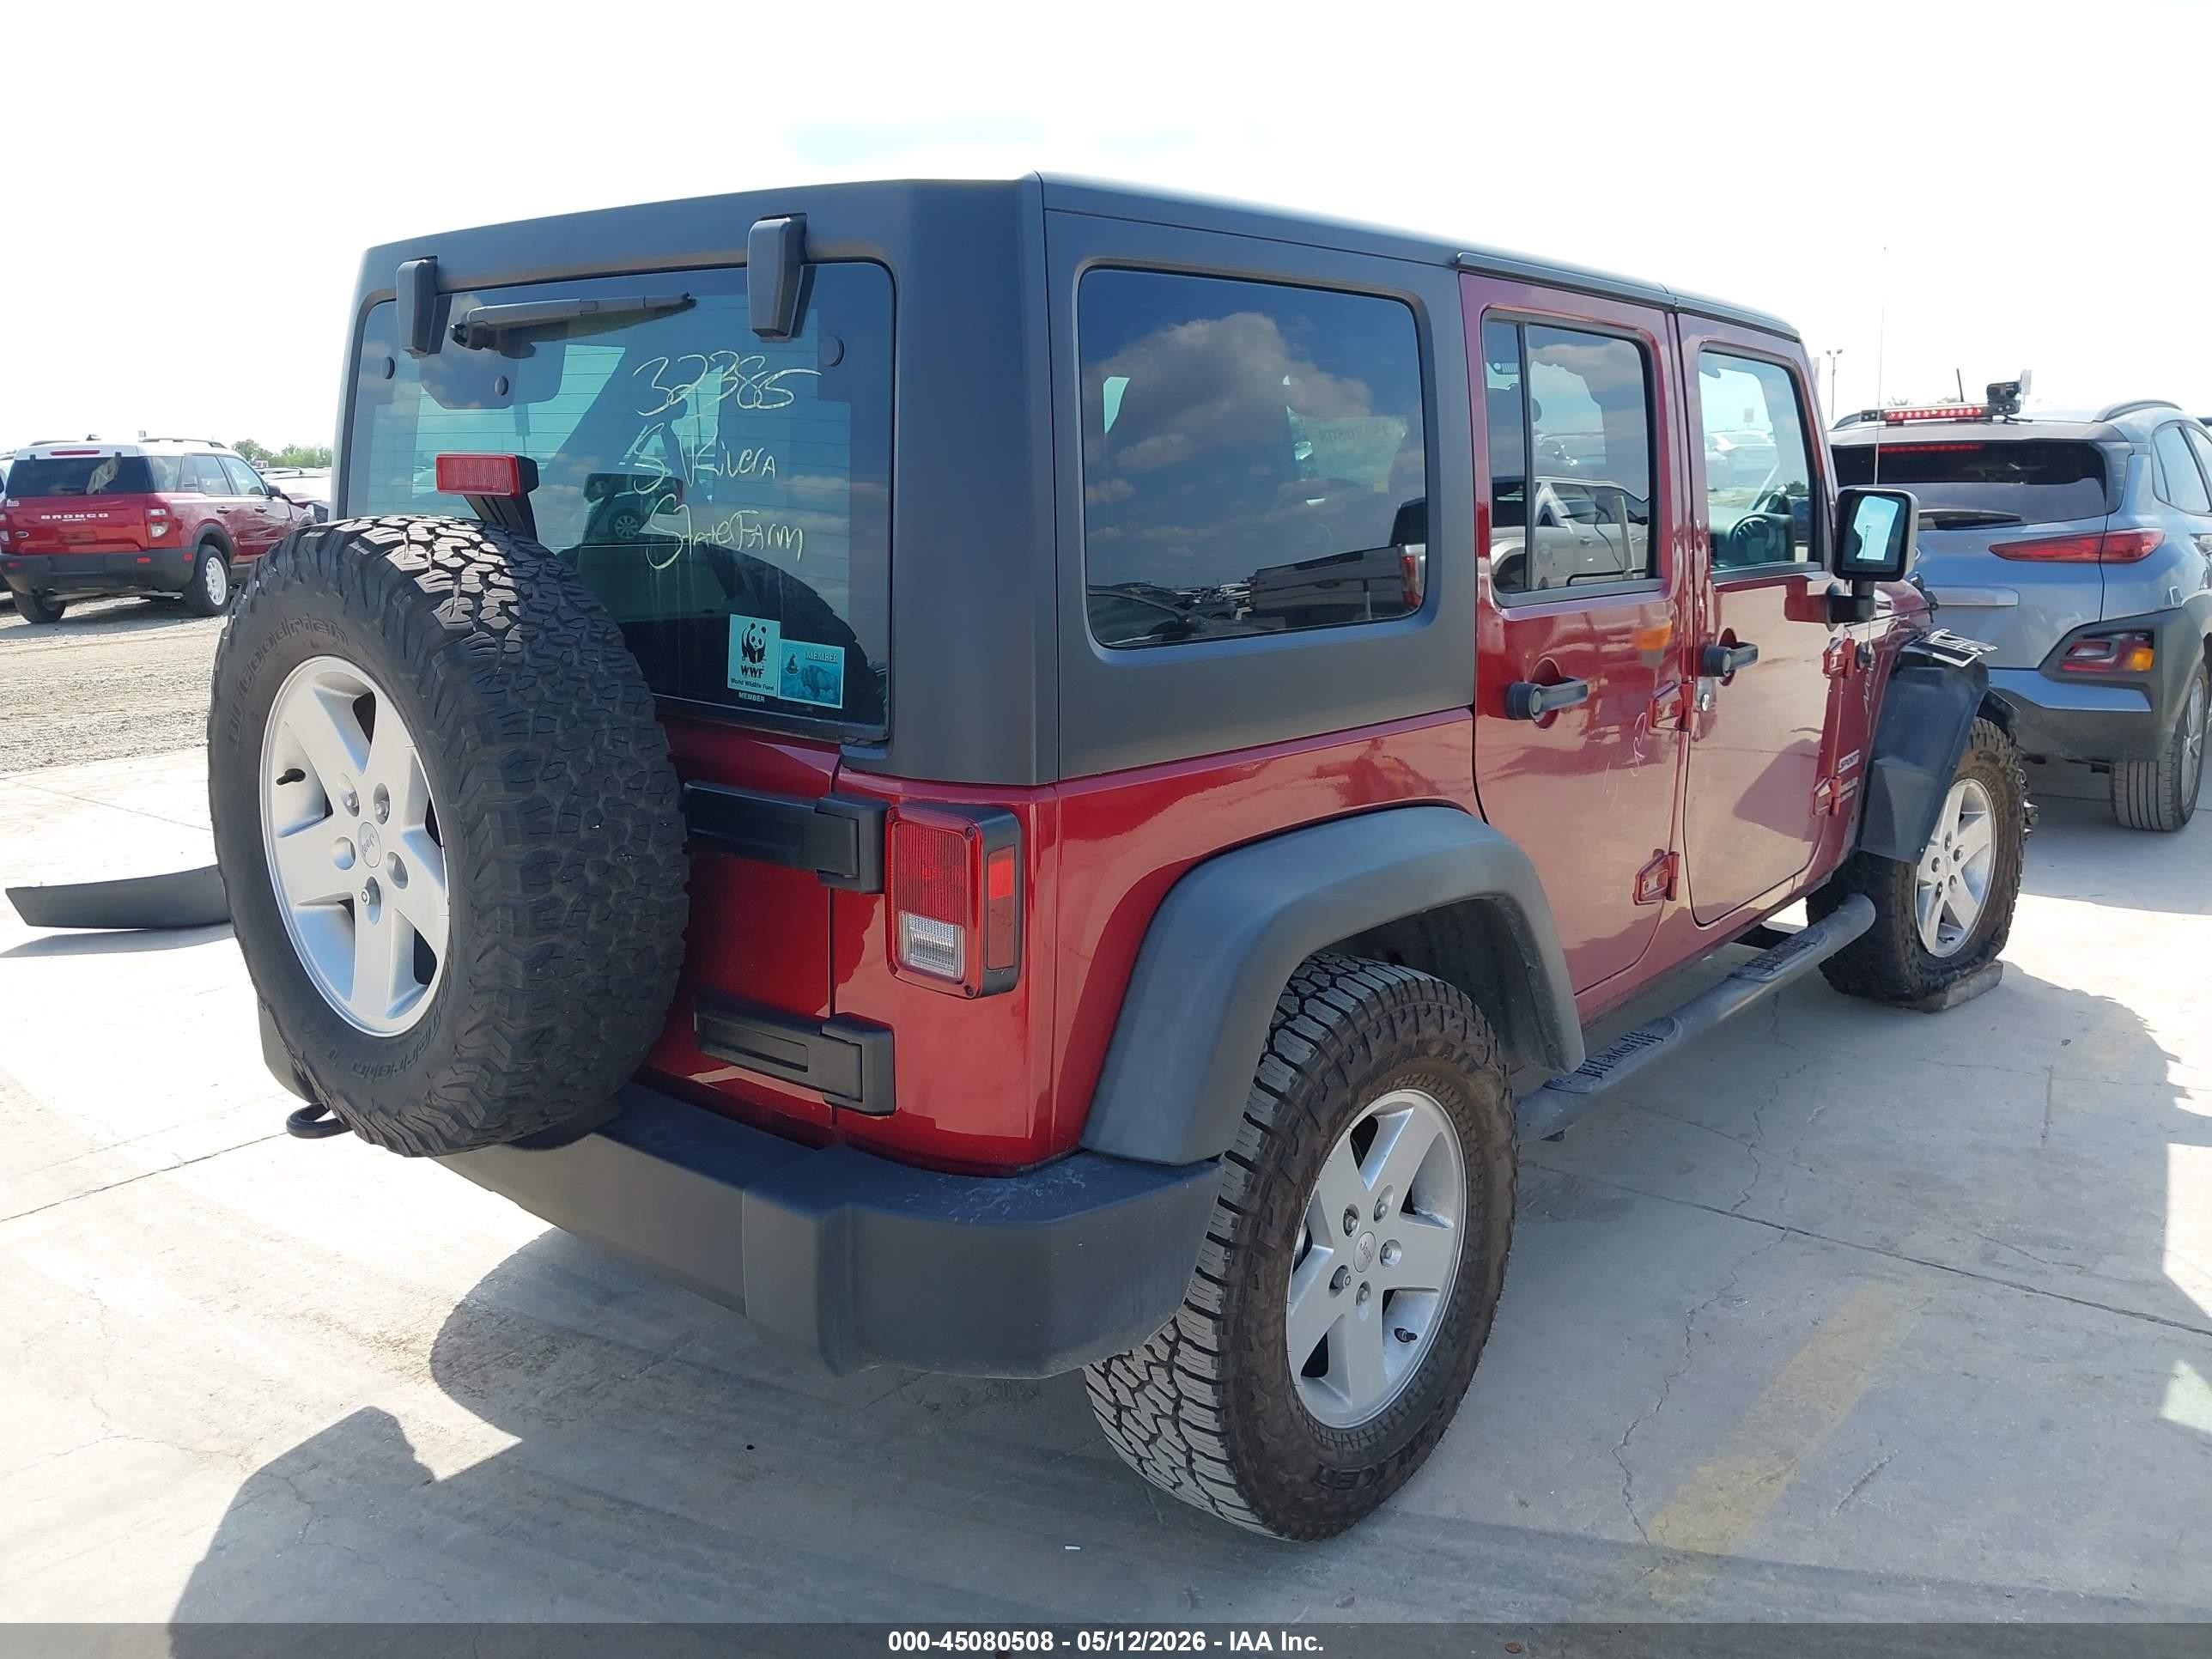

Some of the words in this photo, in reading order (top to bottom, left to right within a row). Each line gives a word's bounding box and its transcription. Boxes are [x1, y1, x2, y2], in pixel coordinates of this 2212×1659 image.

[805, 651, 838, 664] MEMBER
[740, 665, 765, 679] WWF
[731, 678, 744, 686] World
[744, 680, 762, 689] Wildlife
[763, 683, 775, 691] Fund
[738, 691, 765, 702] MEMBER
